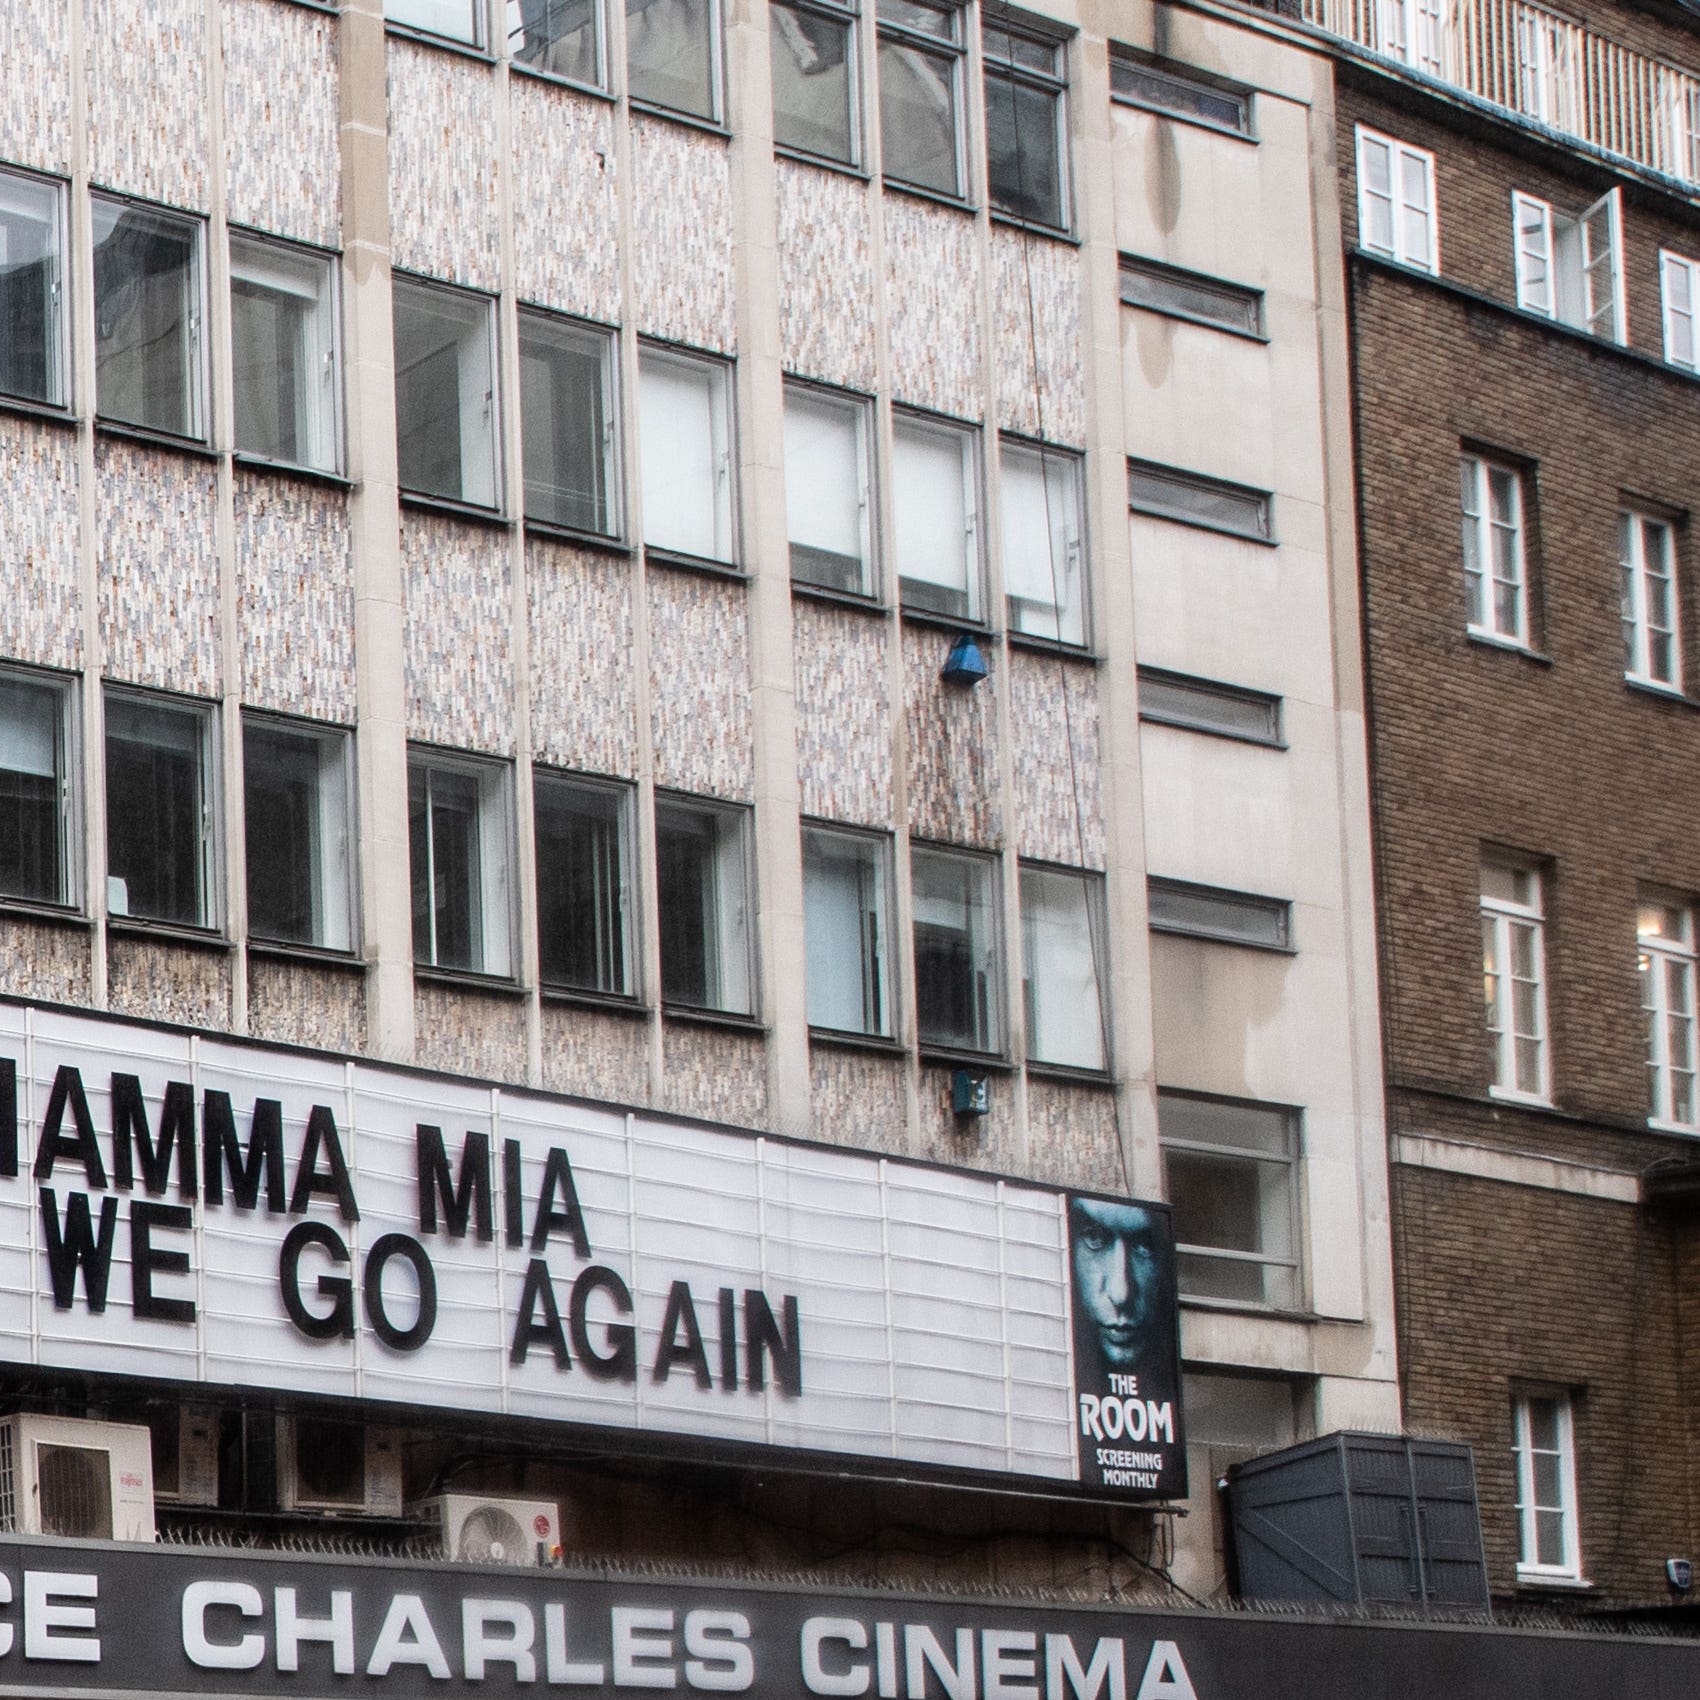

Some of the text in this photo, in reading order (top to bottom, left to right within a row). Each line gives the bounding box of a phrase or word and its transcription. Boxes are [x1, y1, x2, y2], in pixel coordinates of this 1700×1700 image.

[416, 1124, 592, 1259] MIA
[40, 1186, 197, 1324] WE
[278, 1221, 439, 1352] GO
[510, 1258, 802, 1398] AGAIN
[1108, 1373, 1139, 1396] THE
[1079, 1393, 1175, 1444] ROOM
[1096, 1447, 1163, 1470] SCREENING
[1103, 1468, 1160, 1489] MONTHLY
[179, 1579, 757, 1696] CHARLES
